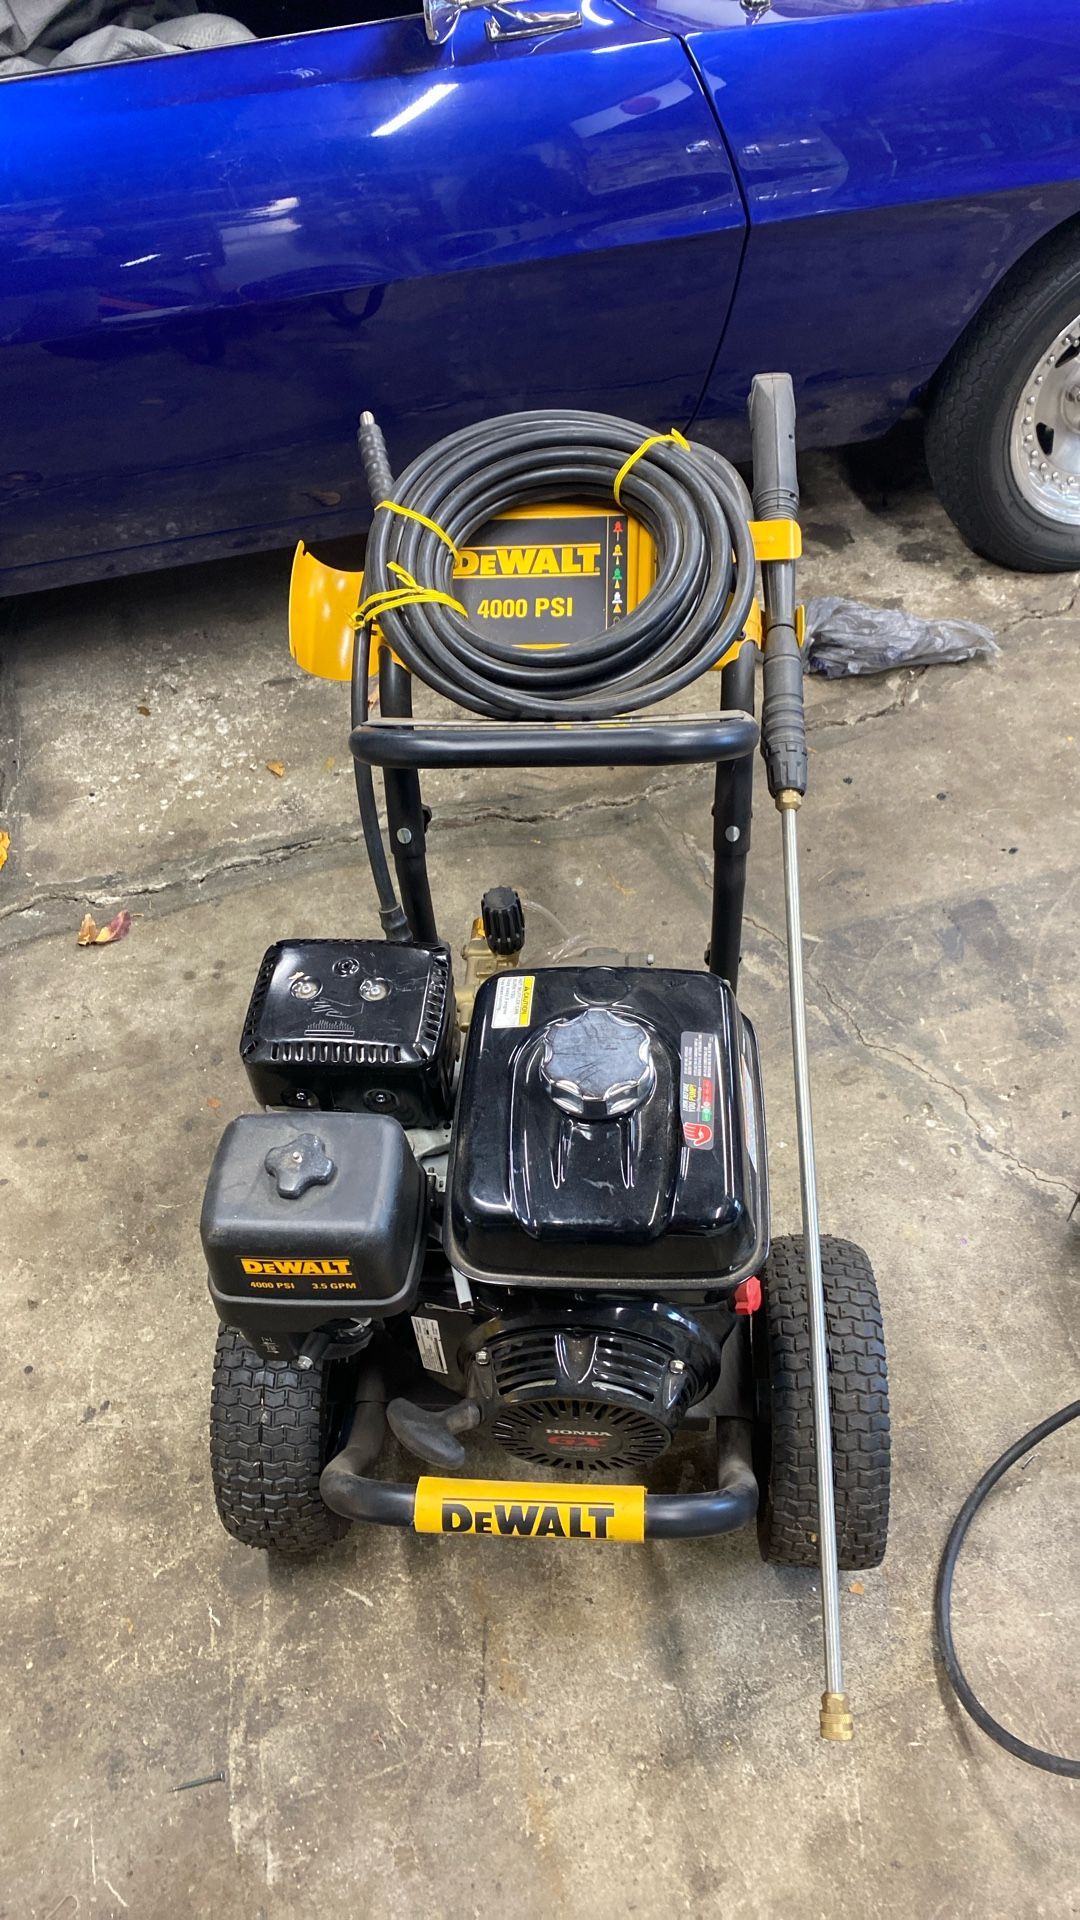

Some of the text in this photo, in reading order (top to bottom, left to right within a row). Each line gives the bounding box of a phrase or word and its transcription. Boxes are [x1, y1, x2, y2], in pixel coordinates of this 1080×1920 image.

[477, 597, 573, 619] 4000 PSI
[522, 991, 531, 1015] CAUTION
[241, 1259, 351, 1275] DEWALT
[250, 1281, 357, 1290] 4000 PSI 3.5 GPM
[545, 1428, 613, 1437] HONDA
[547, 1435, 608, 1447] GX
[441, 1503, 615, 1539] DEWALT
